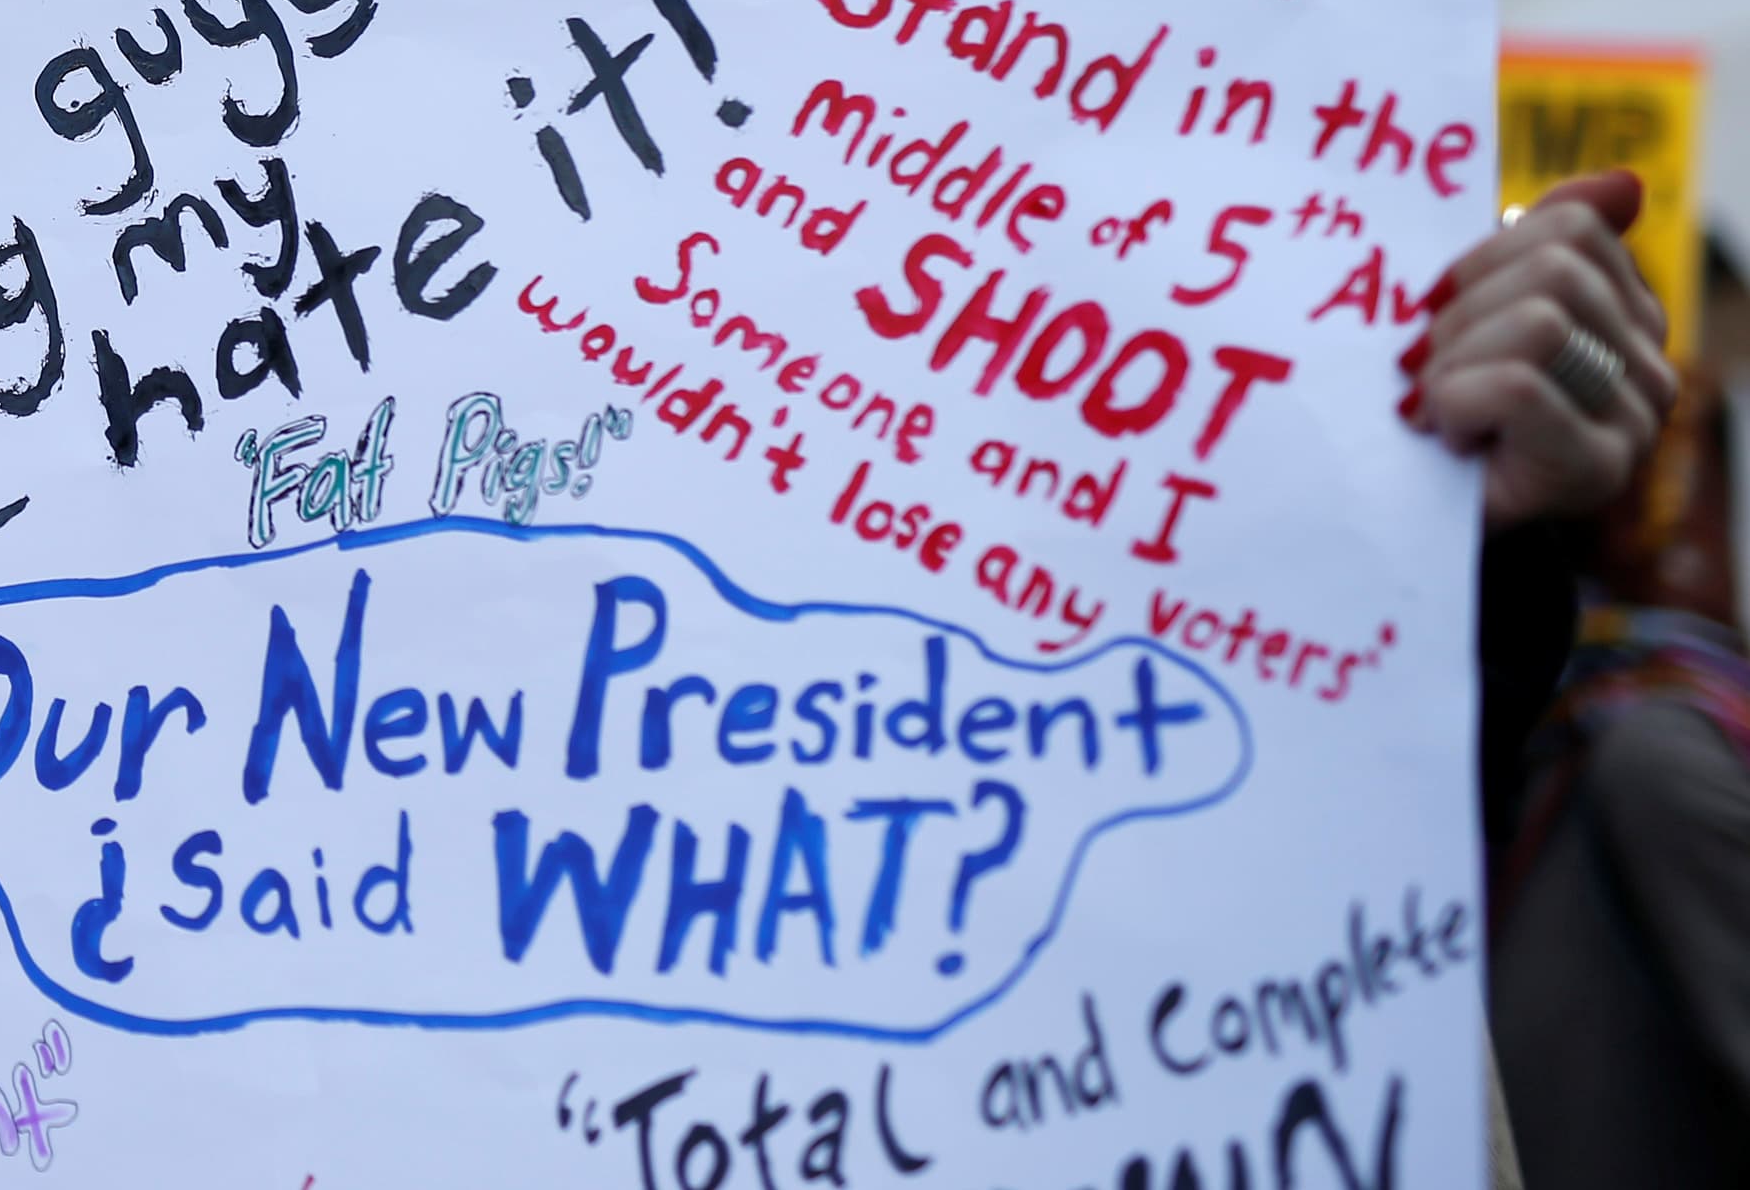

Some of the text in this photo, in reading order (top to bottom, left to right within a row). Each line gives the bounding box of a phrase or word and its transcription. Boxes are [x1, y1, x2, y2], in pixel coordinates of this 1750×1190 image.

[1178, 46, 1275, 146] in
[1309, 78, 1477, 199] the
[110, 156, 297, 307] my
[713, 156, 1295, 464] and SHOOT
[1088, 197, 1174, 260] of
[92, 192, 499, 468] hate
[828, 461, 966, 577] lose
[977, 540, 1107, 655] any
[970, 437, 1130, 529] and
[1131, 471, 1220, 566] I
[242, 567, 525, 806] New
[565, 575, 1209, 780] President
[492, 778, 1027, 978] WHAT?
[978, 990, 1123, 1135] and
